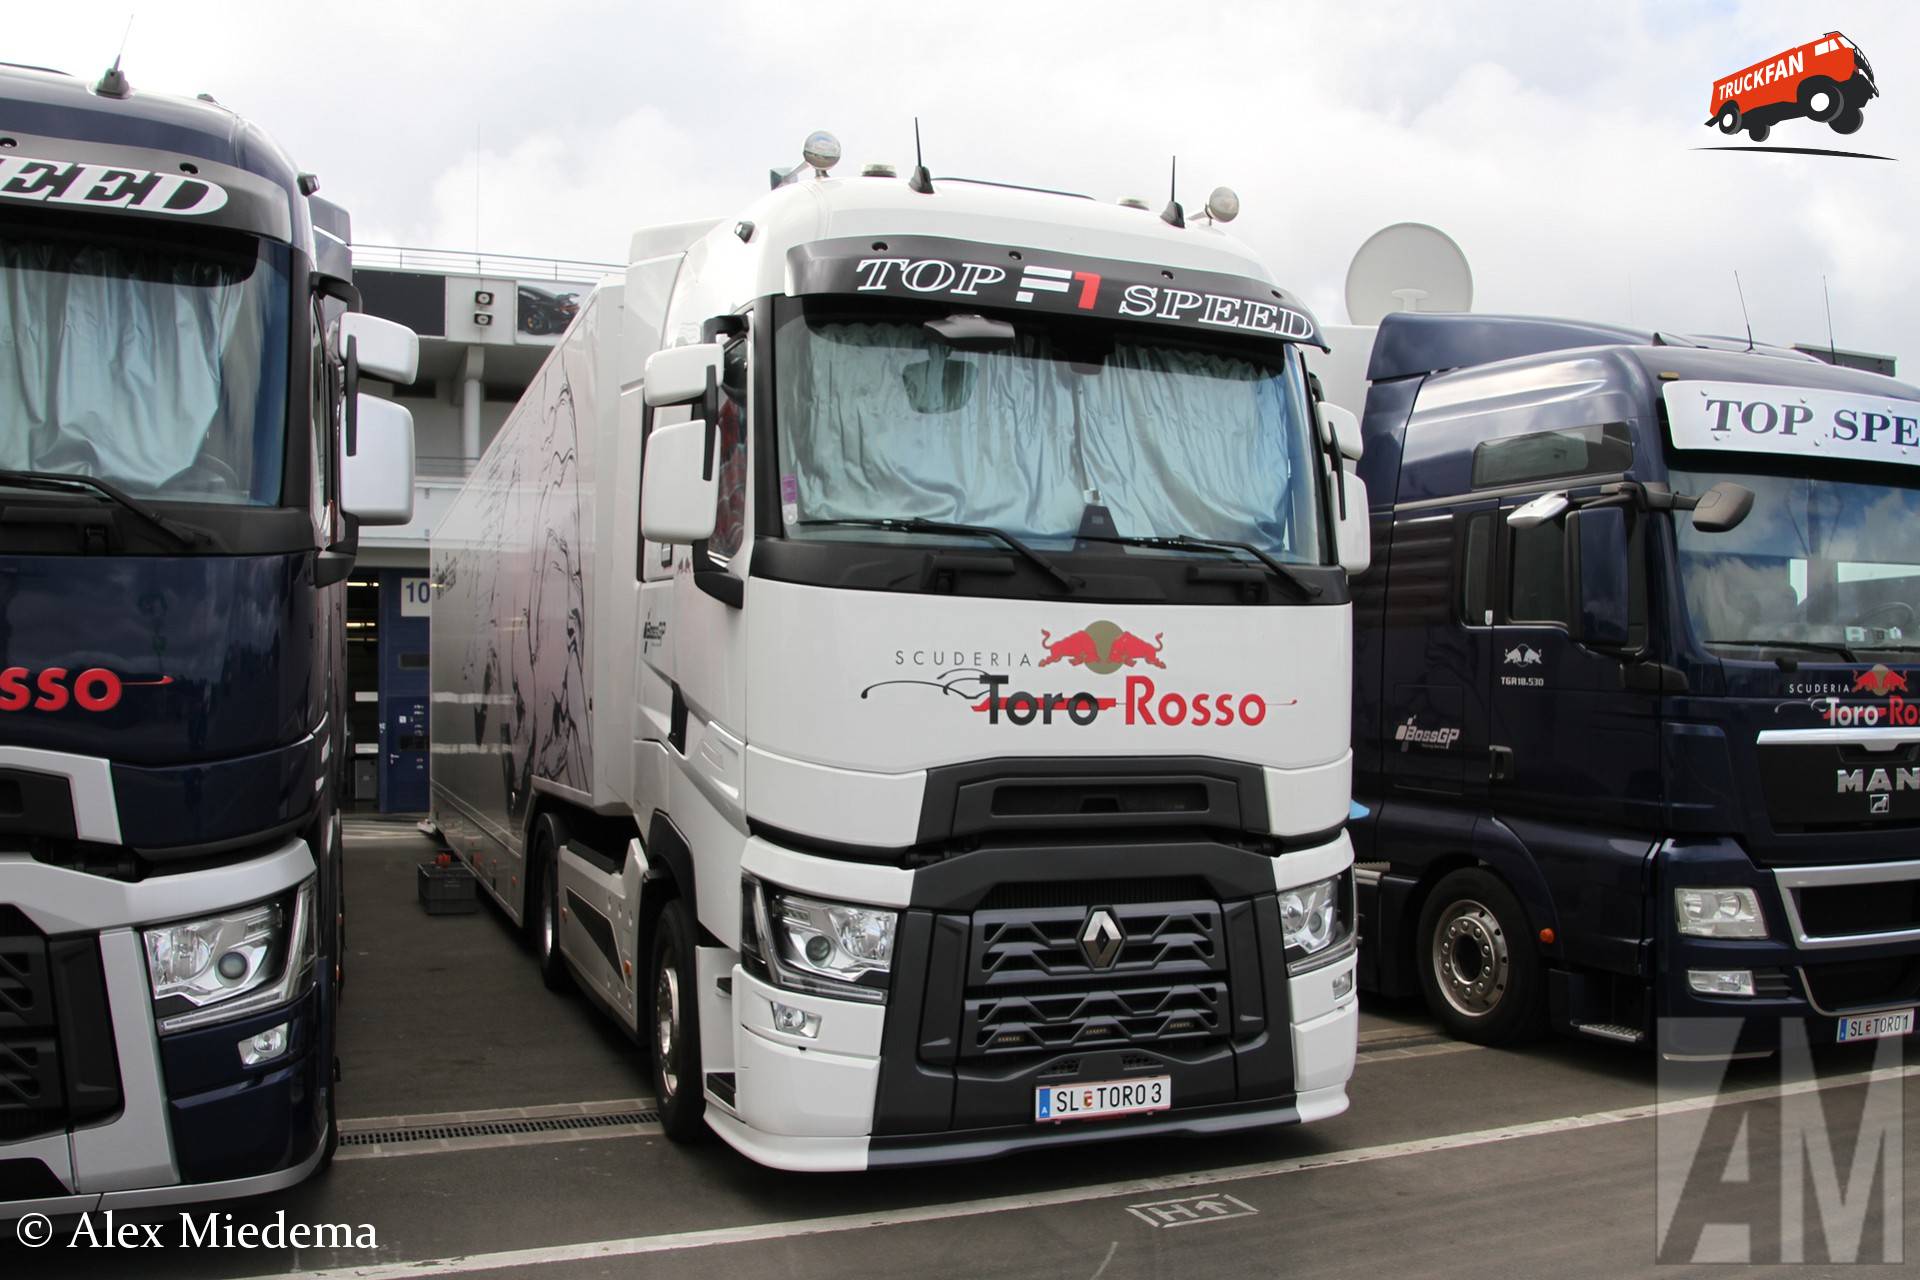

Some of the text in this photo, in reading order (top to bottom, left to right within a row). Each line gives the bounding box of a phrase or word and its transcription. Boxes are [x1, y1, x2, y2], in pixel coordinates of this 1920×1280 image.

[856, 258, 1314, 340] TOP F1 SPEED
[1705, 399, 1814, 436] TOP
[406, 581, 430, 604] 10
[895, 650, 1032, 667] SCUDERIA
[979, 674, 1266, 727] Toro Rosso
[1789, 683, 1850, 694] SCUDERIA
[1826, 695, 1920, 726] Toro Ro
[1837, 767, 1920, 793] MAN
[1056, 1090, 1079, 1112] SL
